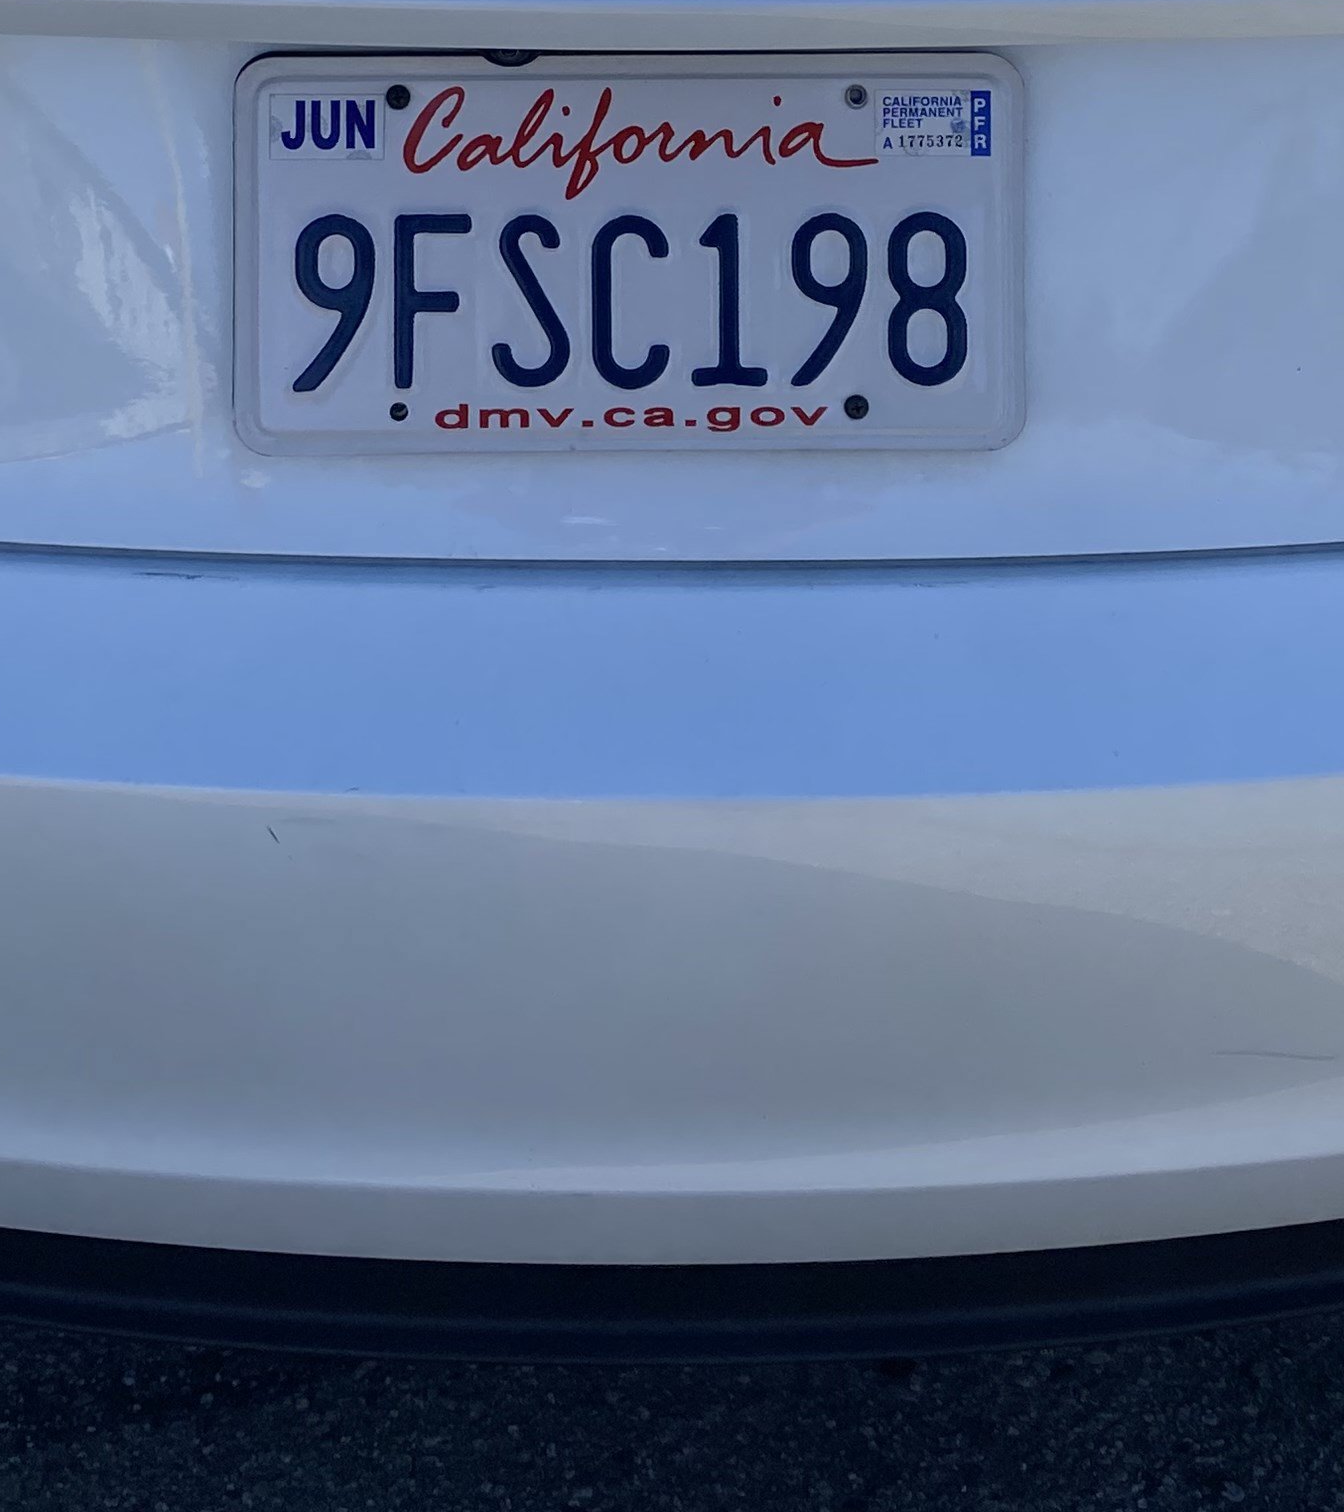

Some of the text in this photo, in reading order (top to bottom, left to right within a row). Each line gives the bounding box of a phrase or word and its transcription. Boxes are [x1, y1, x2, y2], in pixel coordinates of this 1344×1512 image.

[882, 96, 962, 107] CALIFORNIA
[882, 107, 963, 118] PERMANENT
[281, 100, 376, 151] JUN
[882, 118, 923, 128] FLEET
[973, 98, 987, 149] PFR
[404, 88, 878, 199] California
[882, 134, 963, 149] A 1775372
[292, 212, 969, 393] 9FSC198
[434, 403, 829, 432] dmv.ca.gov
